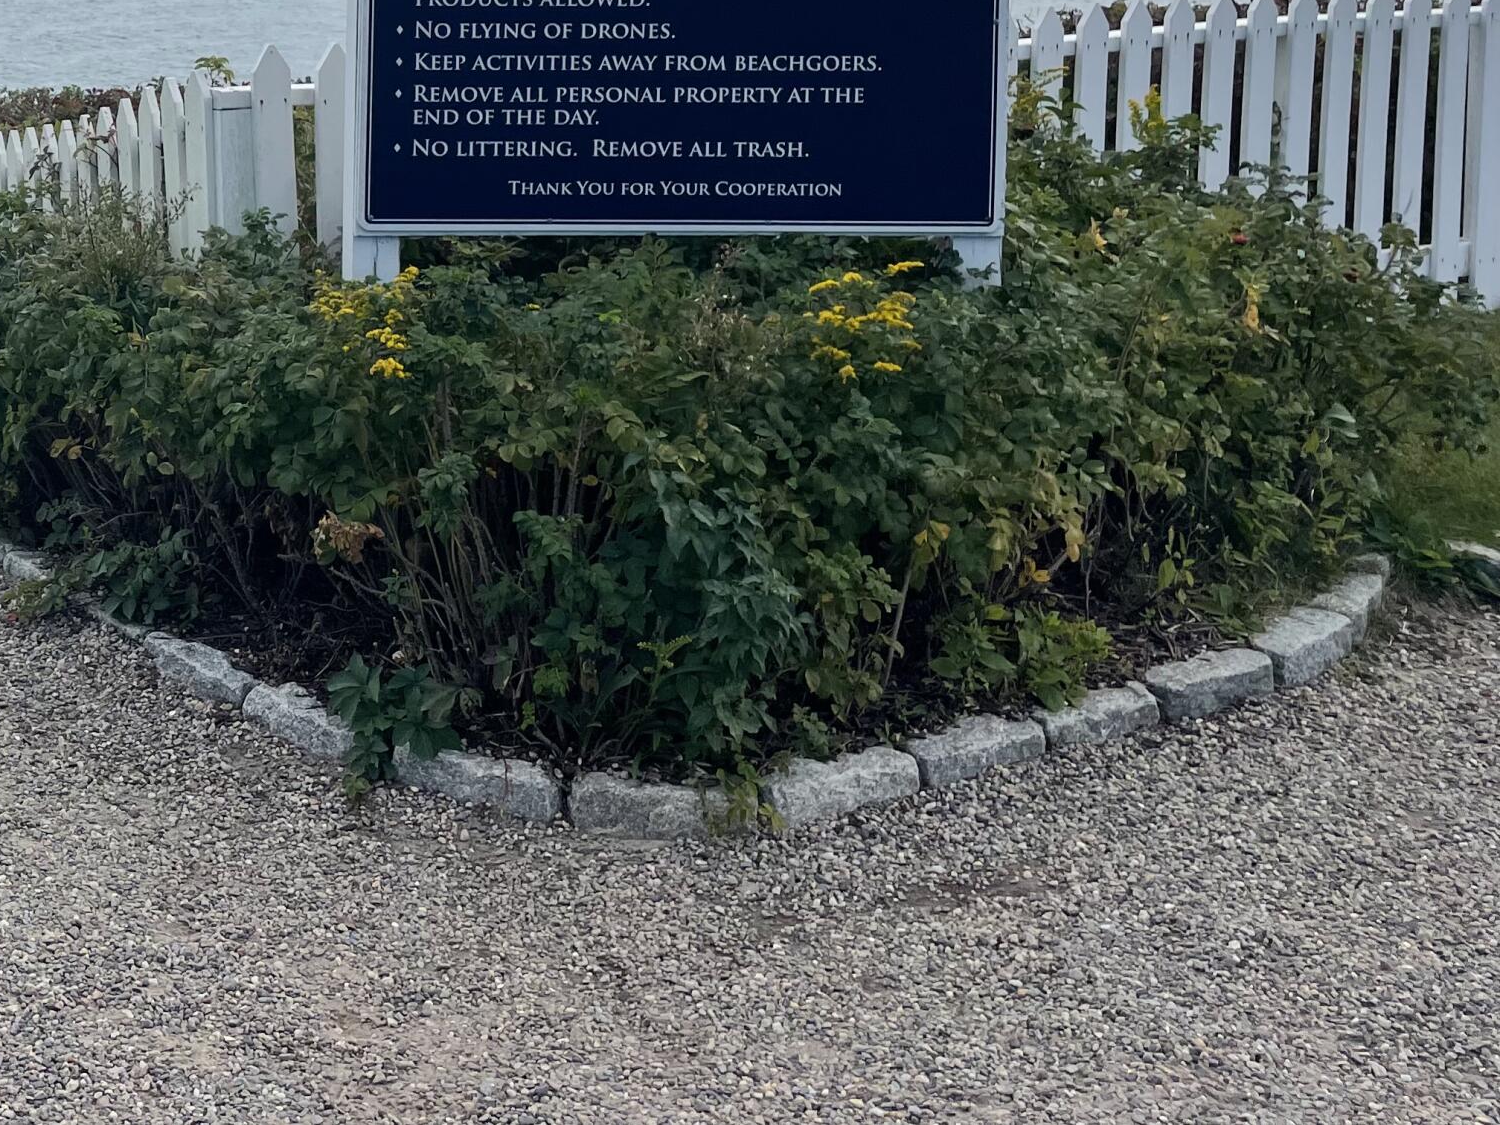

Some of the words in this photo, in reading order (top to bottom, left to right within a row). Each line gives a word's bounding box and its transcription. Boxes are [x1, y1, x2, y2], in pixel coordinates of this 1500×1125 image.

[415, 20, 452, 39] NO
[459, 22, 536, 39] FLYING
[543, 22, 573, 39] OF
[581, 22, 676, 40] DRONES.
[414, 52, 466, 71] KEEP
[471, 54, 592, 71] ACTIVITIES
[597, 54, 658, 71] AWAY
[664, 55, 727, 72] FROM
[735, 54, 882, 72] BEACHGOERS.
[414, 84, 504, 103] REMOVE
[509, 86, 549, 103] ALL
[555, 86, 667, 103] PERSONAL
[673, 86, 783, 104] PROPERTY
[787, 87, 815, 104] AT
[820, 87, 865, 104] THE
[413, 109, 460, 126] END
[466, 109, 495, 125] OF
[501, 109, 546, 125] THE
[554, 109, 600, 126] DAY.
[412, 138, 449, 157] NO
[456, 140, 578, 157] LITTERING.
[592, 138, 683, 158] REMOVE
[688, 141, 727, 158] ALL
[733, 141, 809, 158] TRASH.
[507, 180, 573, 196] THANK
[576, 180, 615, 196] YOU
[621, 182, 656, 196] FOR
[659, 180, 711, 196] YOUR
[714, 180, 842, 197] COOPERATION
